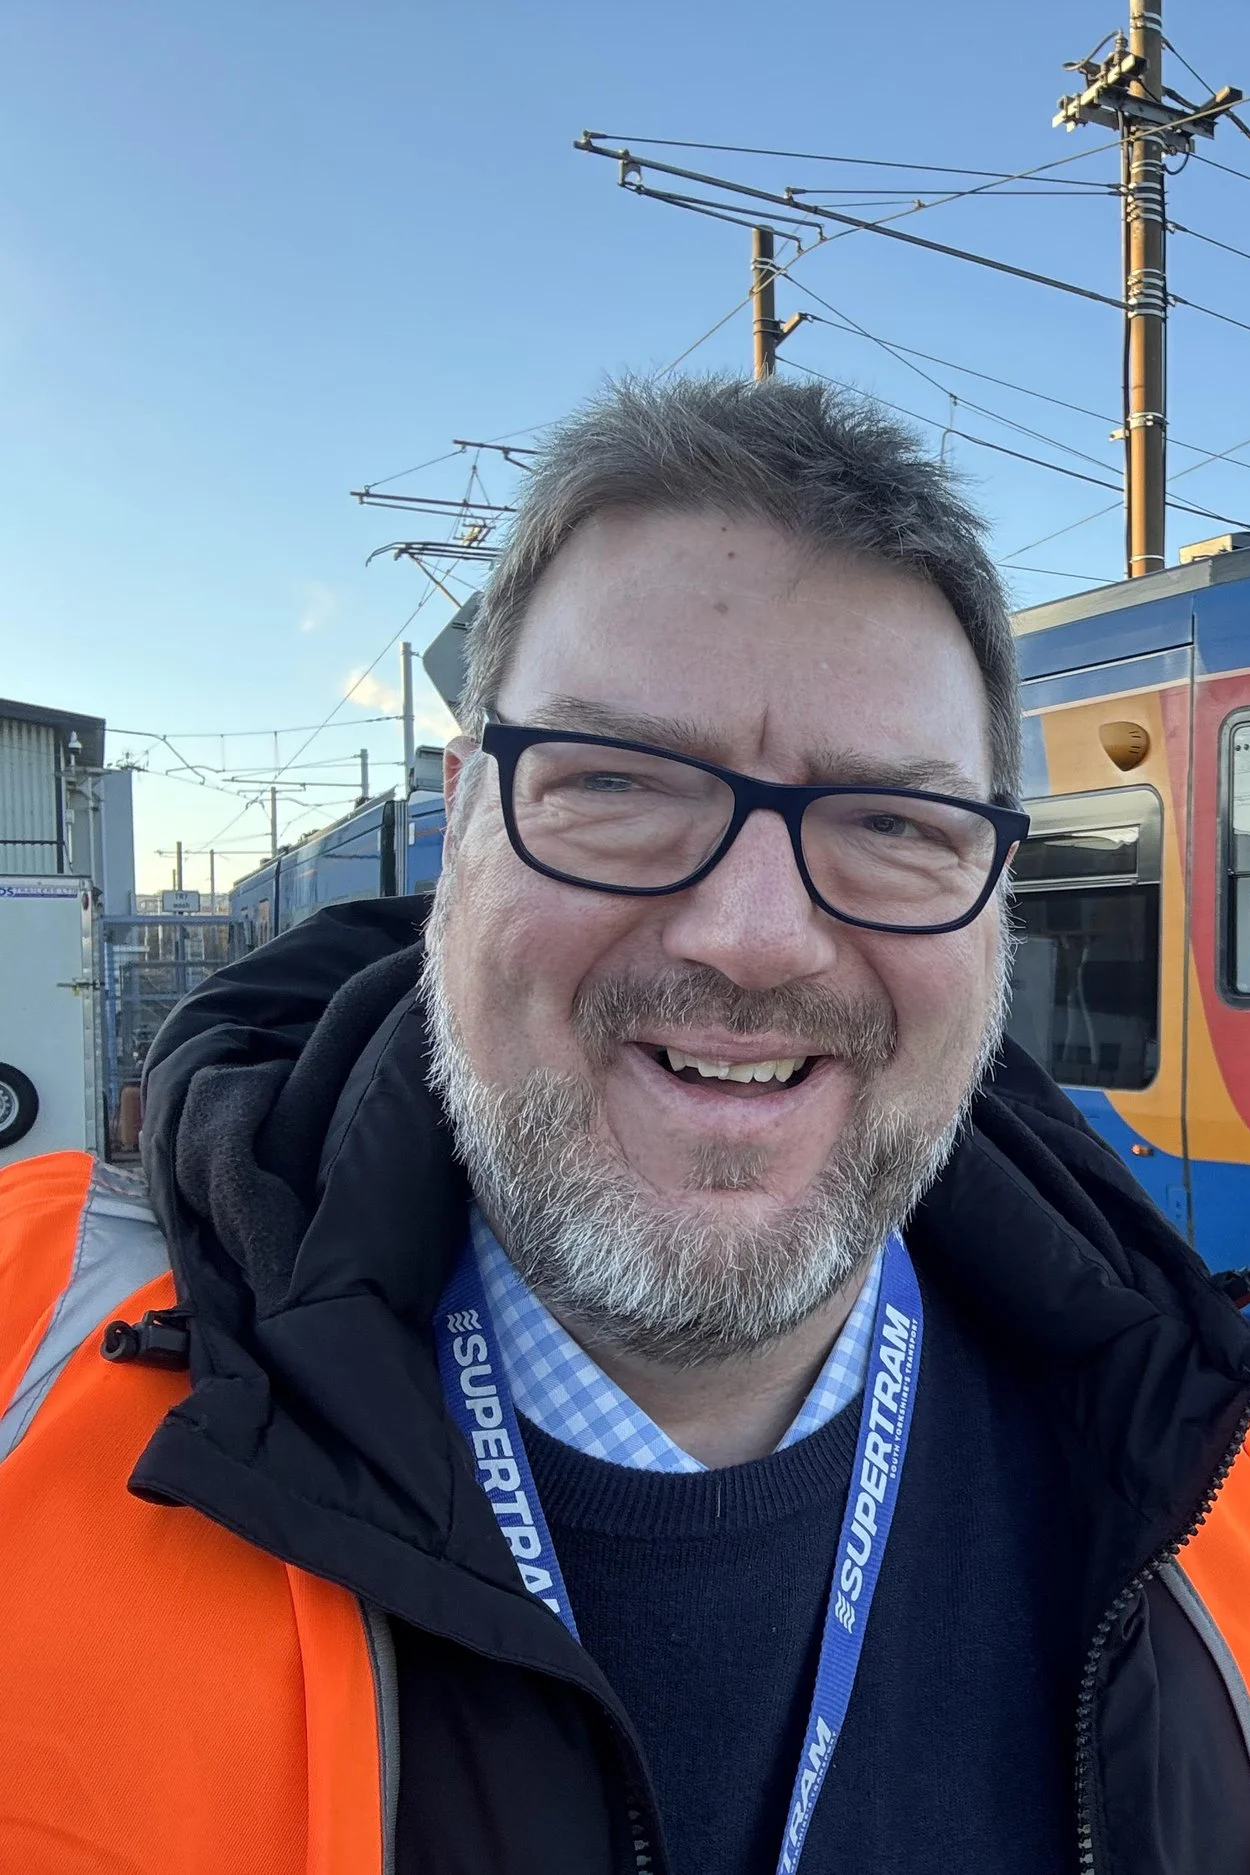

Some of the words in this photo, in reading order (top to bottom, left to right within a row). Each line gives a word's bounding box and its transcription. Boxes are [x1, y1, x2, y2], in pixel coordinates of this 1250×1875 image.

[905, 1318, 918, 1374] TRANSPORT
[894, 1376, 912, 1441] YORKSHIRE'S
[452, 1333, 561, 1614] SUPERTRA
[840, 1303, 911, 1602] SUPERTRAM
[889, 1444, 901, 1479] SOUTH
